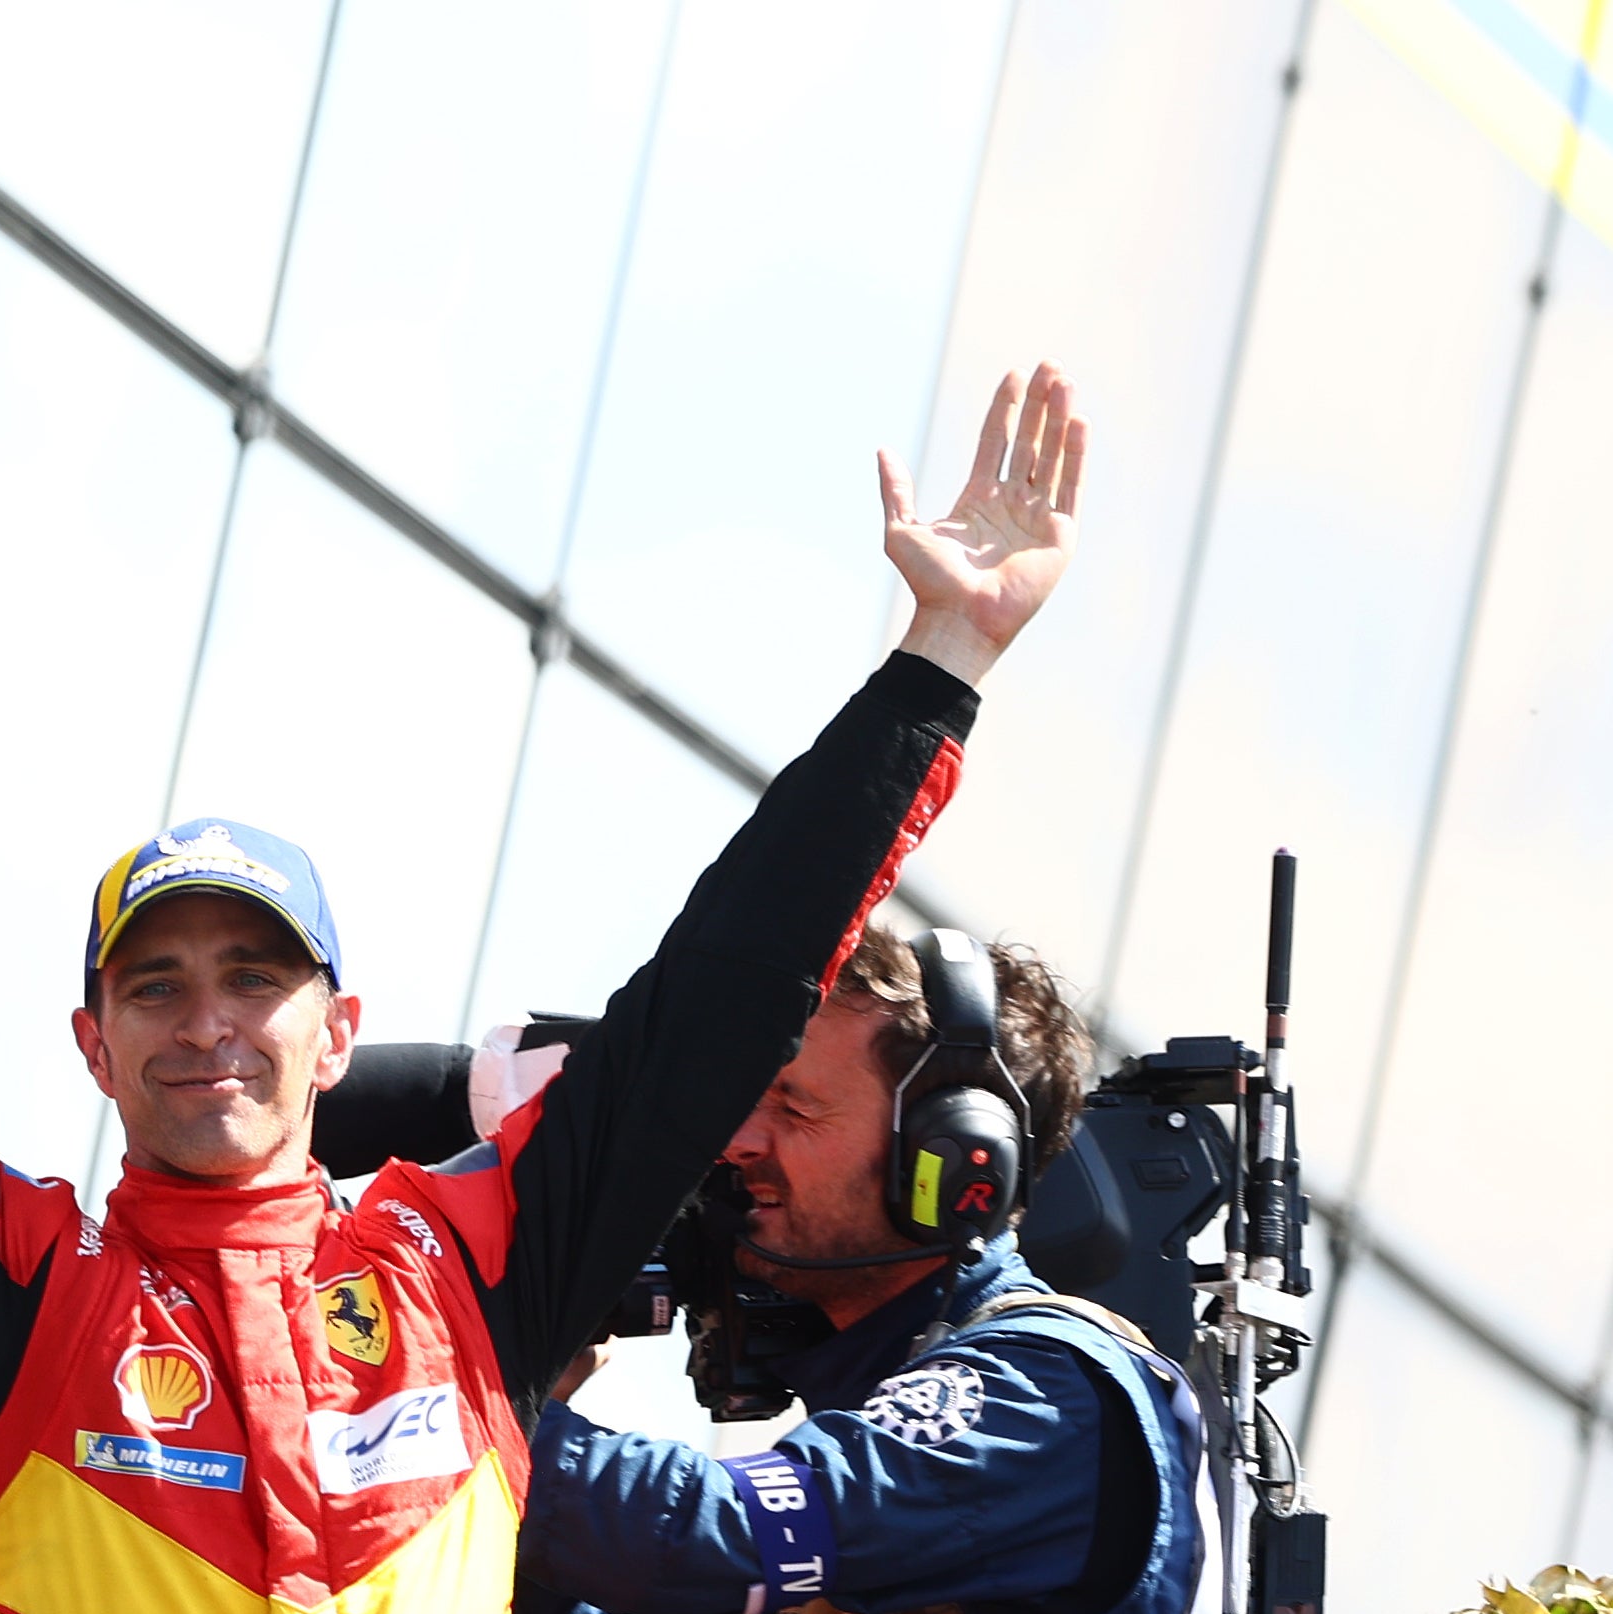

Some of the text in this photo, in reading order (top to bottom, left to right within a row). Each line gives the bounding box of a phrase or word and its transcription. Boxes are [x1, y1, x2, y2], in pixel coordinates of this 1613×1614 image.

[327, 1394, 448, 1457] WEC
[119, 1448, 229, 1479] MICHELIN
[779, 1555, 824, 1593] TV
